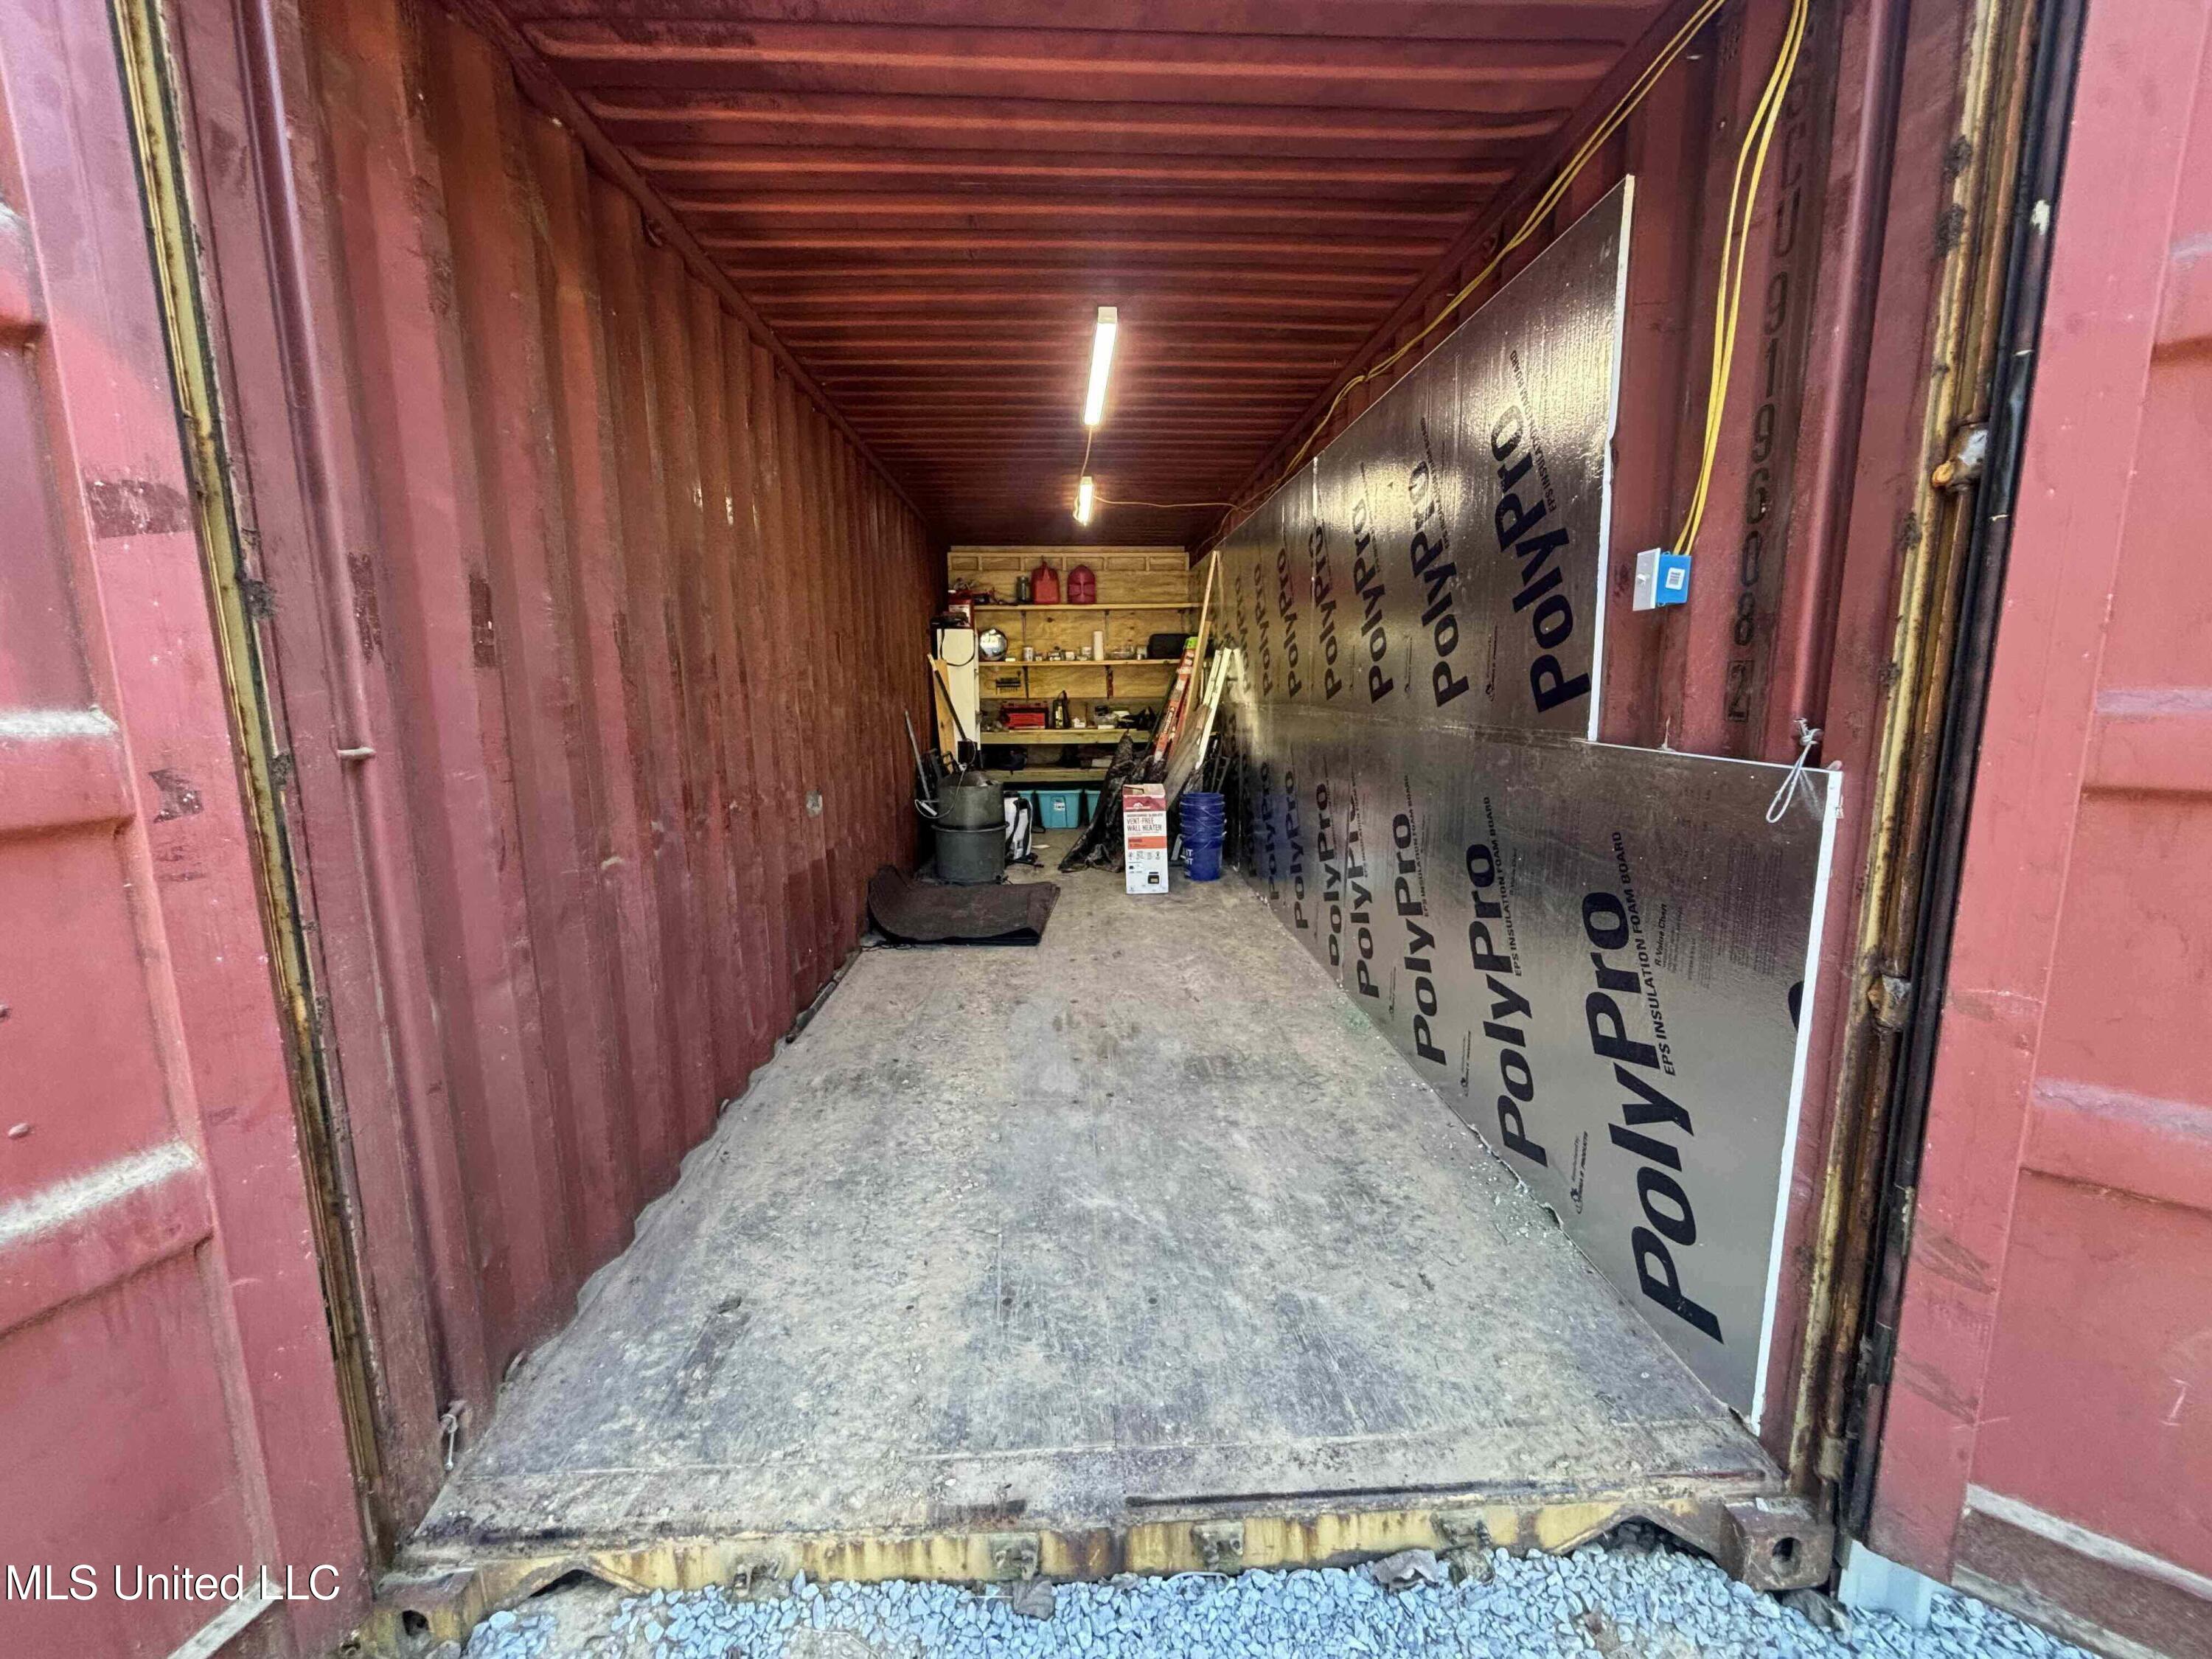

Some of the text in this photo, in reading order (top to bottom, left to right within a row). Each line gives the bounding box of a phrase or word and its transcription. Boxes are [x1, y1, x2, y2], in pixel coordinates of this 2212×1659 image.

[1277, 548, 1302, 698] PolyPro
[1352, 498, 1394, 704] PolyPro
[1408, 461, 1470, 707] PolyPro
[1491, 405, 1590, 713] PolyPro
[1285, 771, 1308, 929] PolyPro
[1316, 783, 1343, 966] PolyPro
[1392, 813, 1447, 1065] PolyPro
[1484, 796, 1522, 977] EPS INSULATION FOAM BOARD
[1612, 830, 1676, 1077] EPS INSULATION FOAM BOARD
[1466, 844, 1548, 1169] PolyPro
[1582, 891, 1724, 1344] PolyPro
